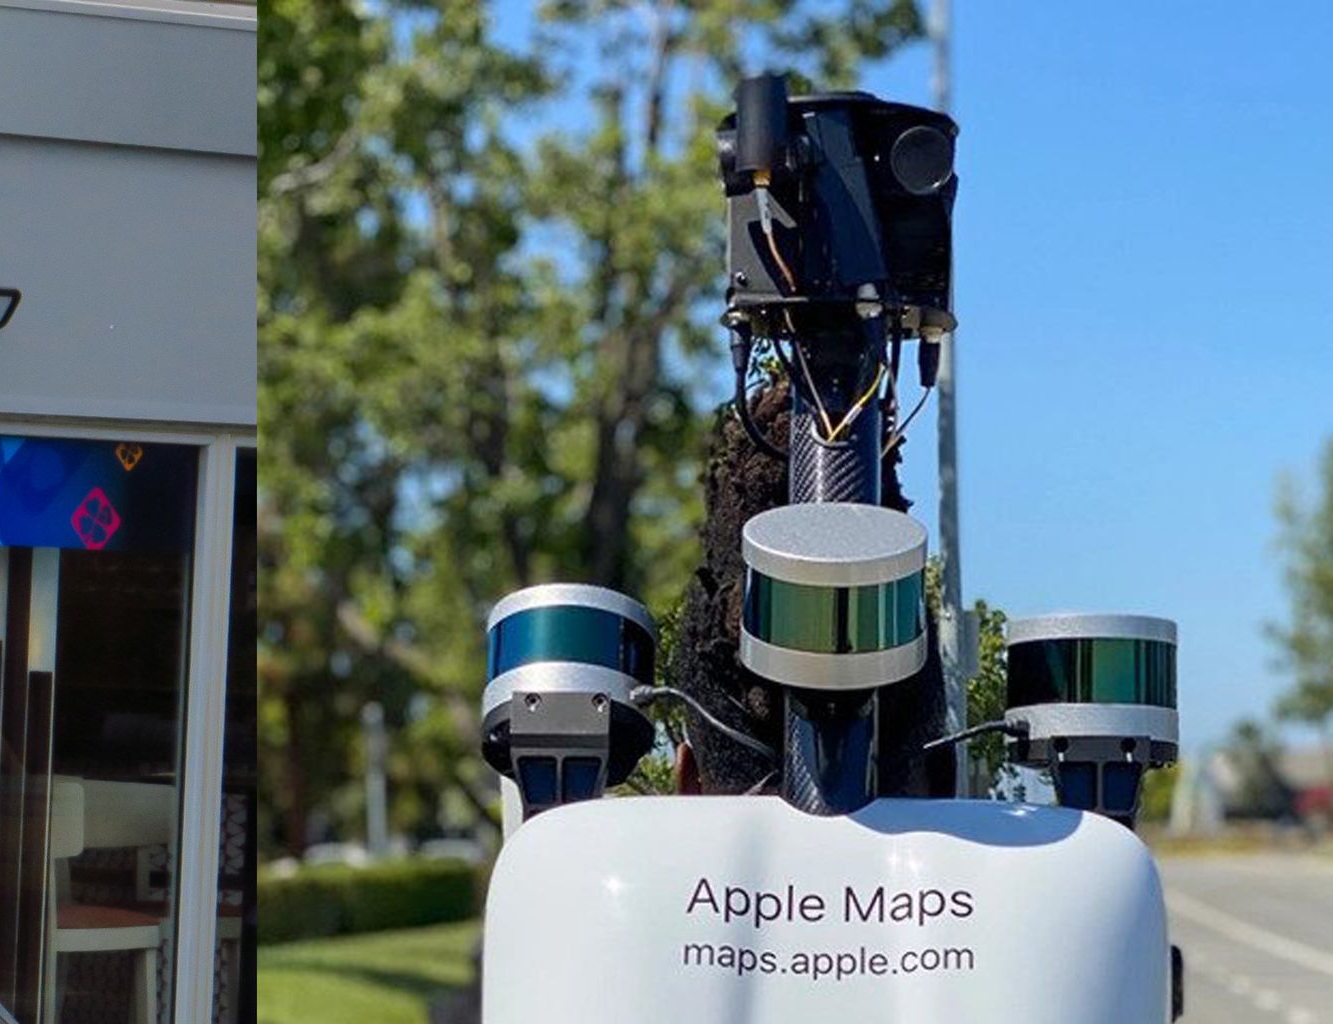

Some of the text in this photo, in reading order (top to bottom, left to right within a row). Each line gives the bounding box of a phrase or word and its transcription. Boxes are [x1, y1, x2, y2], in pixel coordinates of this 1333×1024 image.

[686, 877, 974, 929] Apple Maps
[683, 943, 975, 981] maps.apple.com
